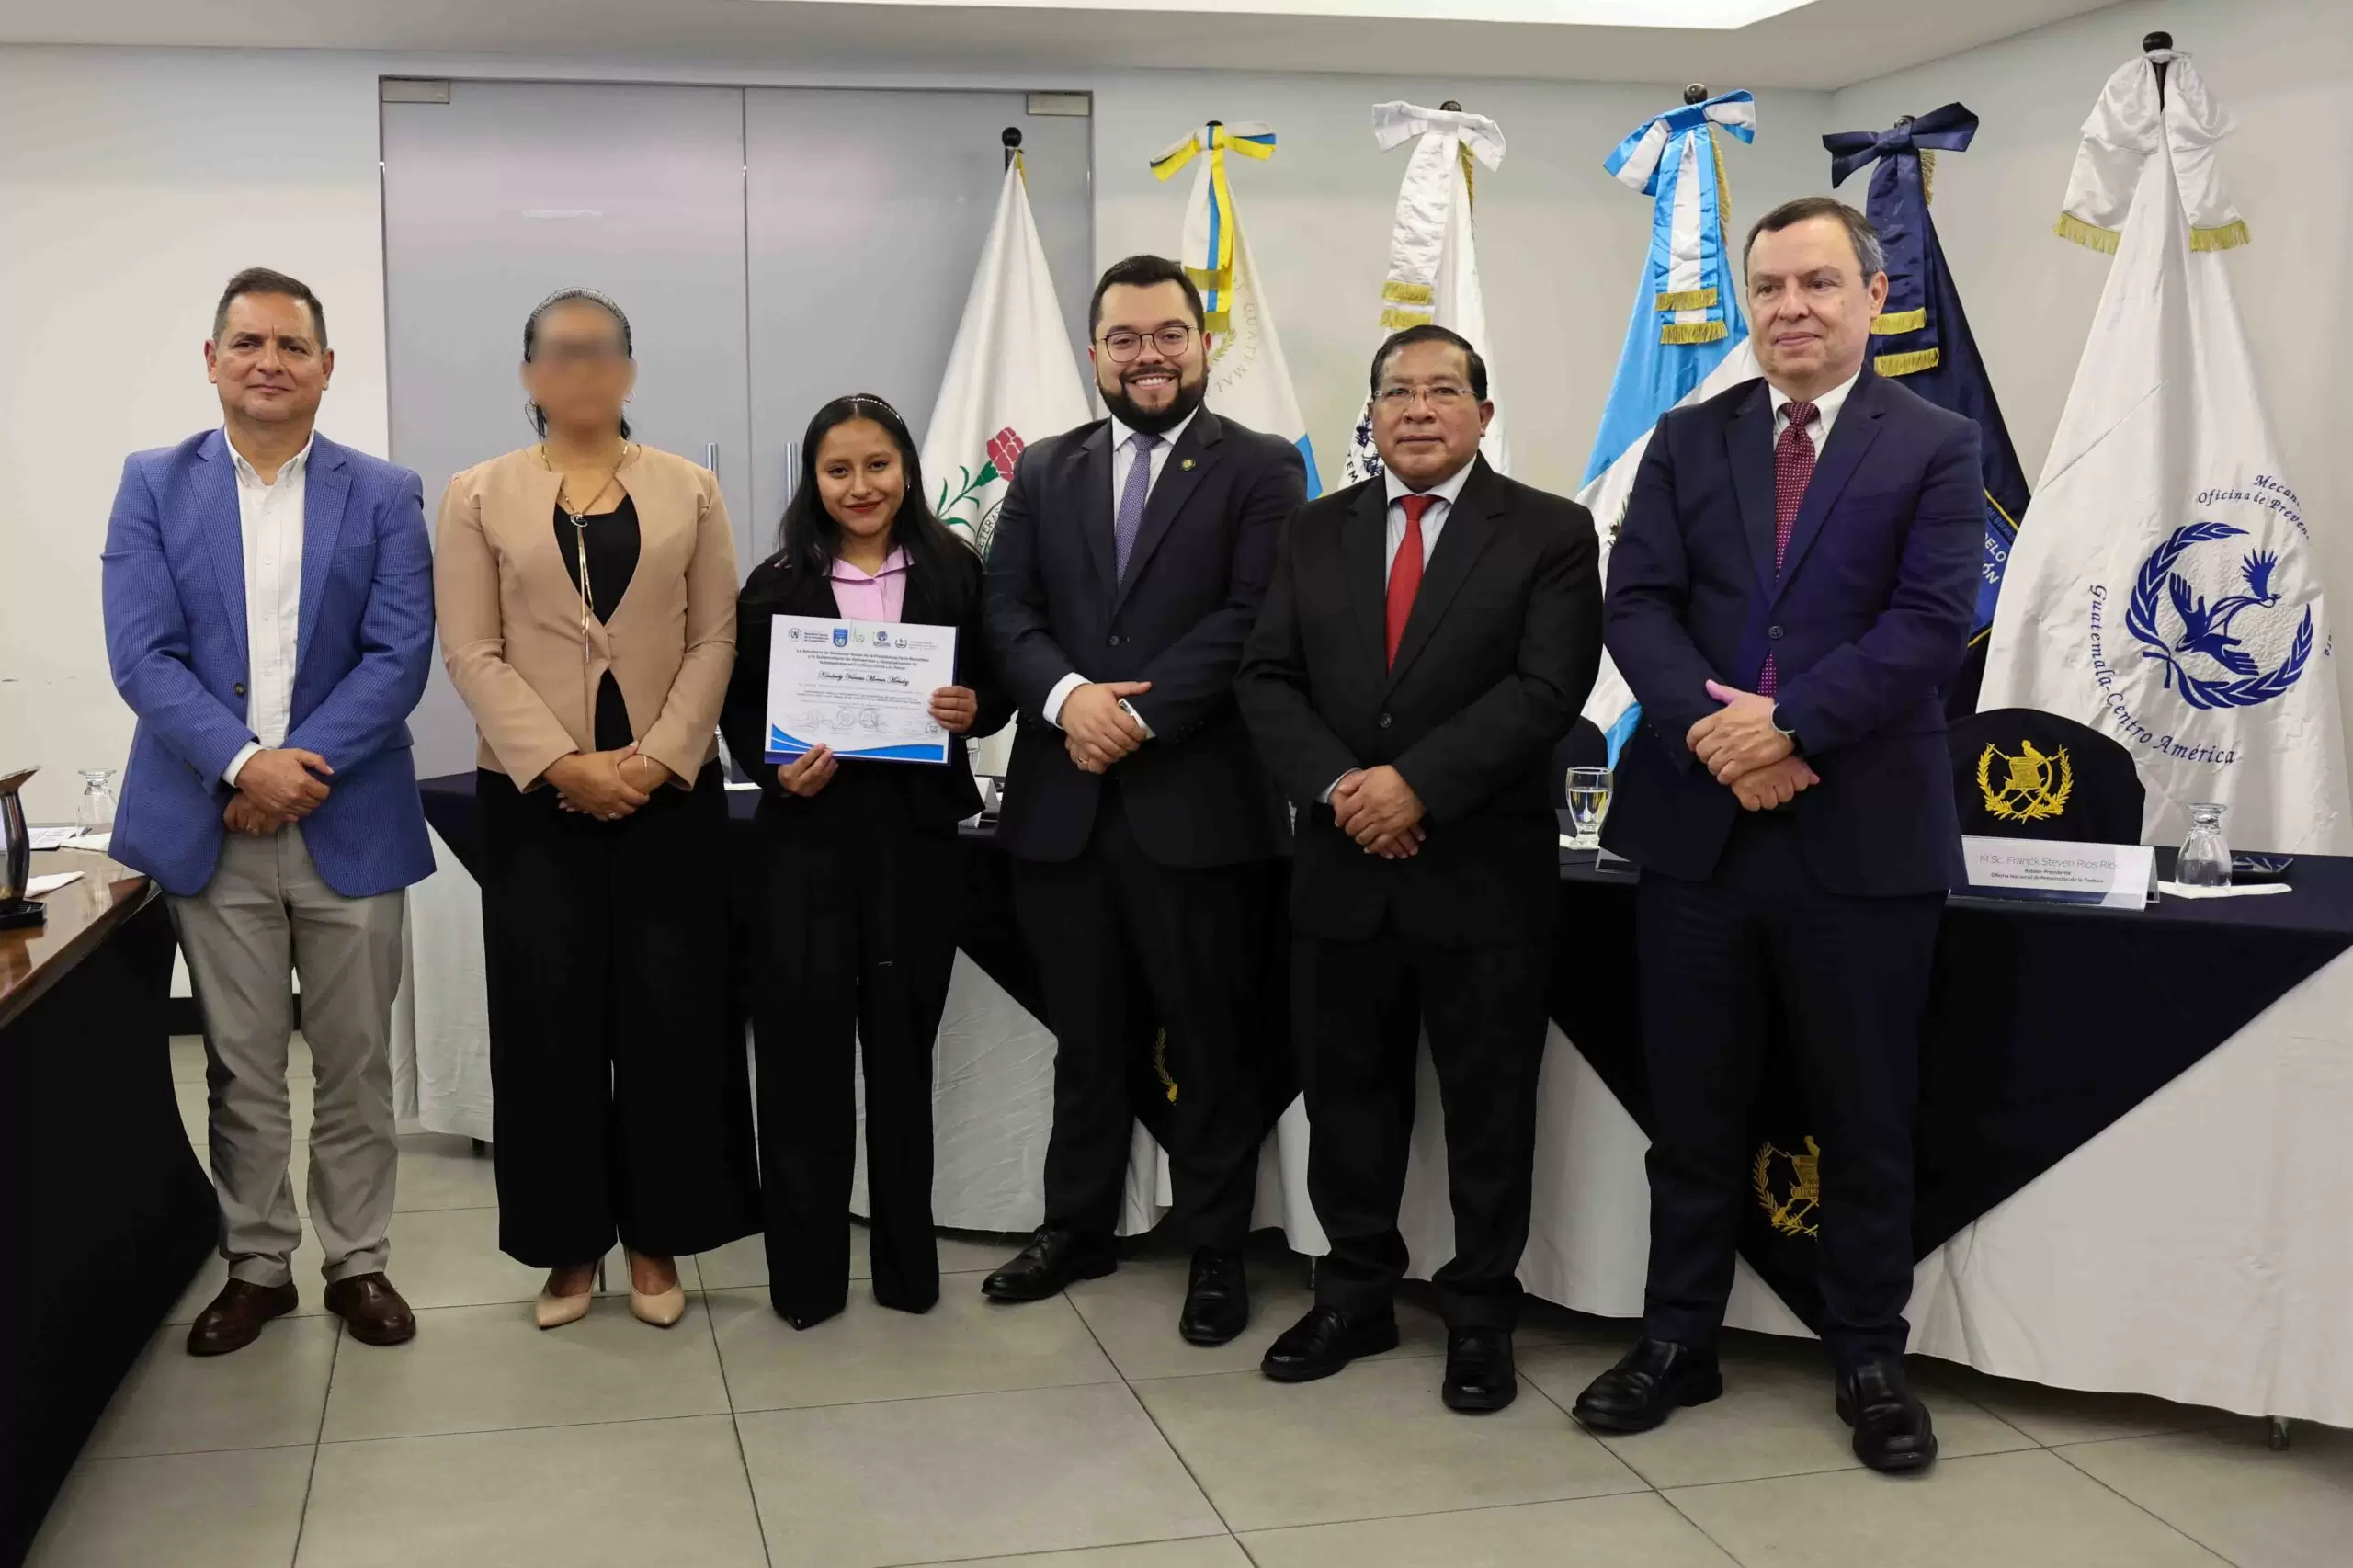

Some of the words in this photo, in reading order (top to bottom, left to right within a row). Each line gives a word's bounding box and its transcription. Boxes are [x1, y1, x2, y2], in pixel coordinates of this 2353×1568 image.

[2198, 489, 2250, 506] Oficina
[2253, 490, 2267, 505] de
[2268, 499, 2311, 540] Preven
[2153, 735, 2235, 764] América
[2041, 857, 2075, 869] Steven
